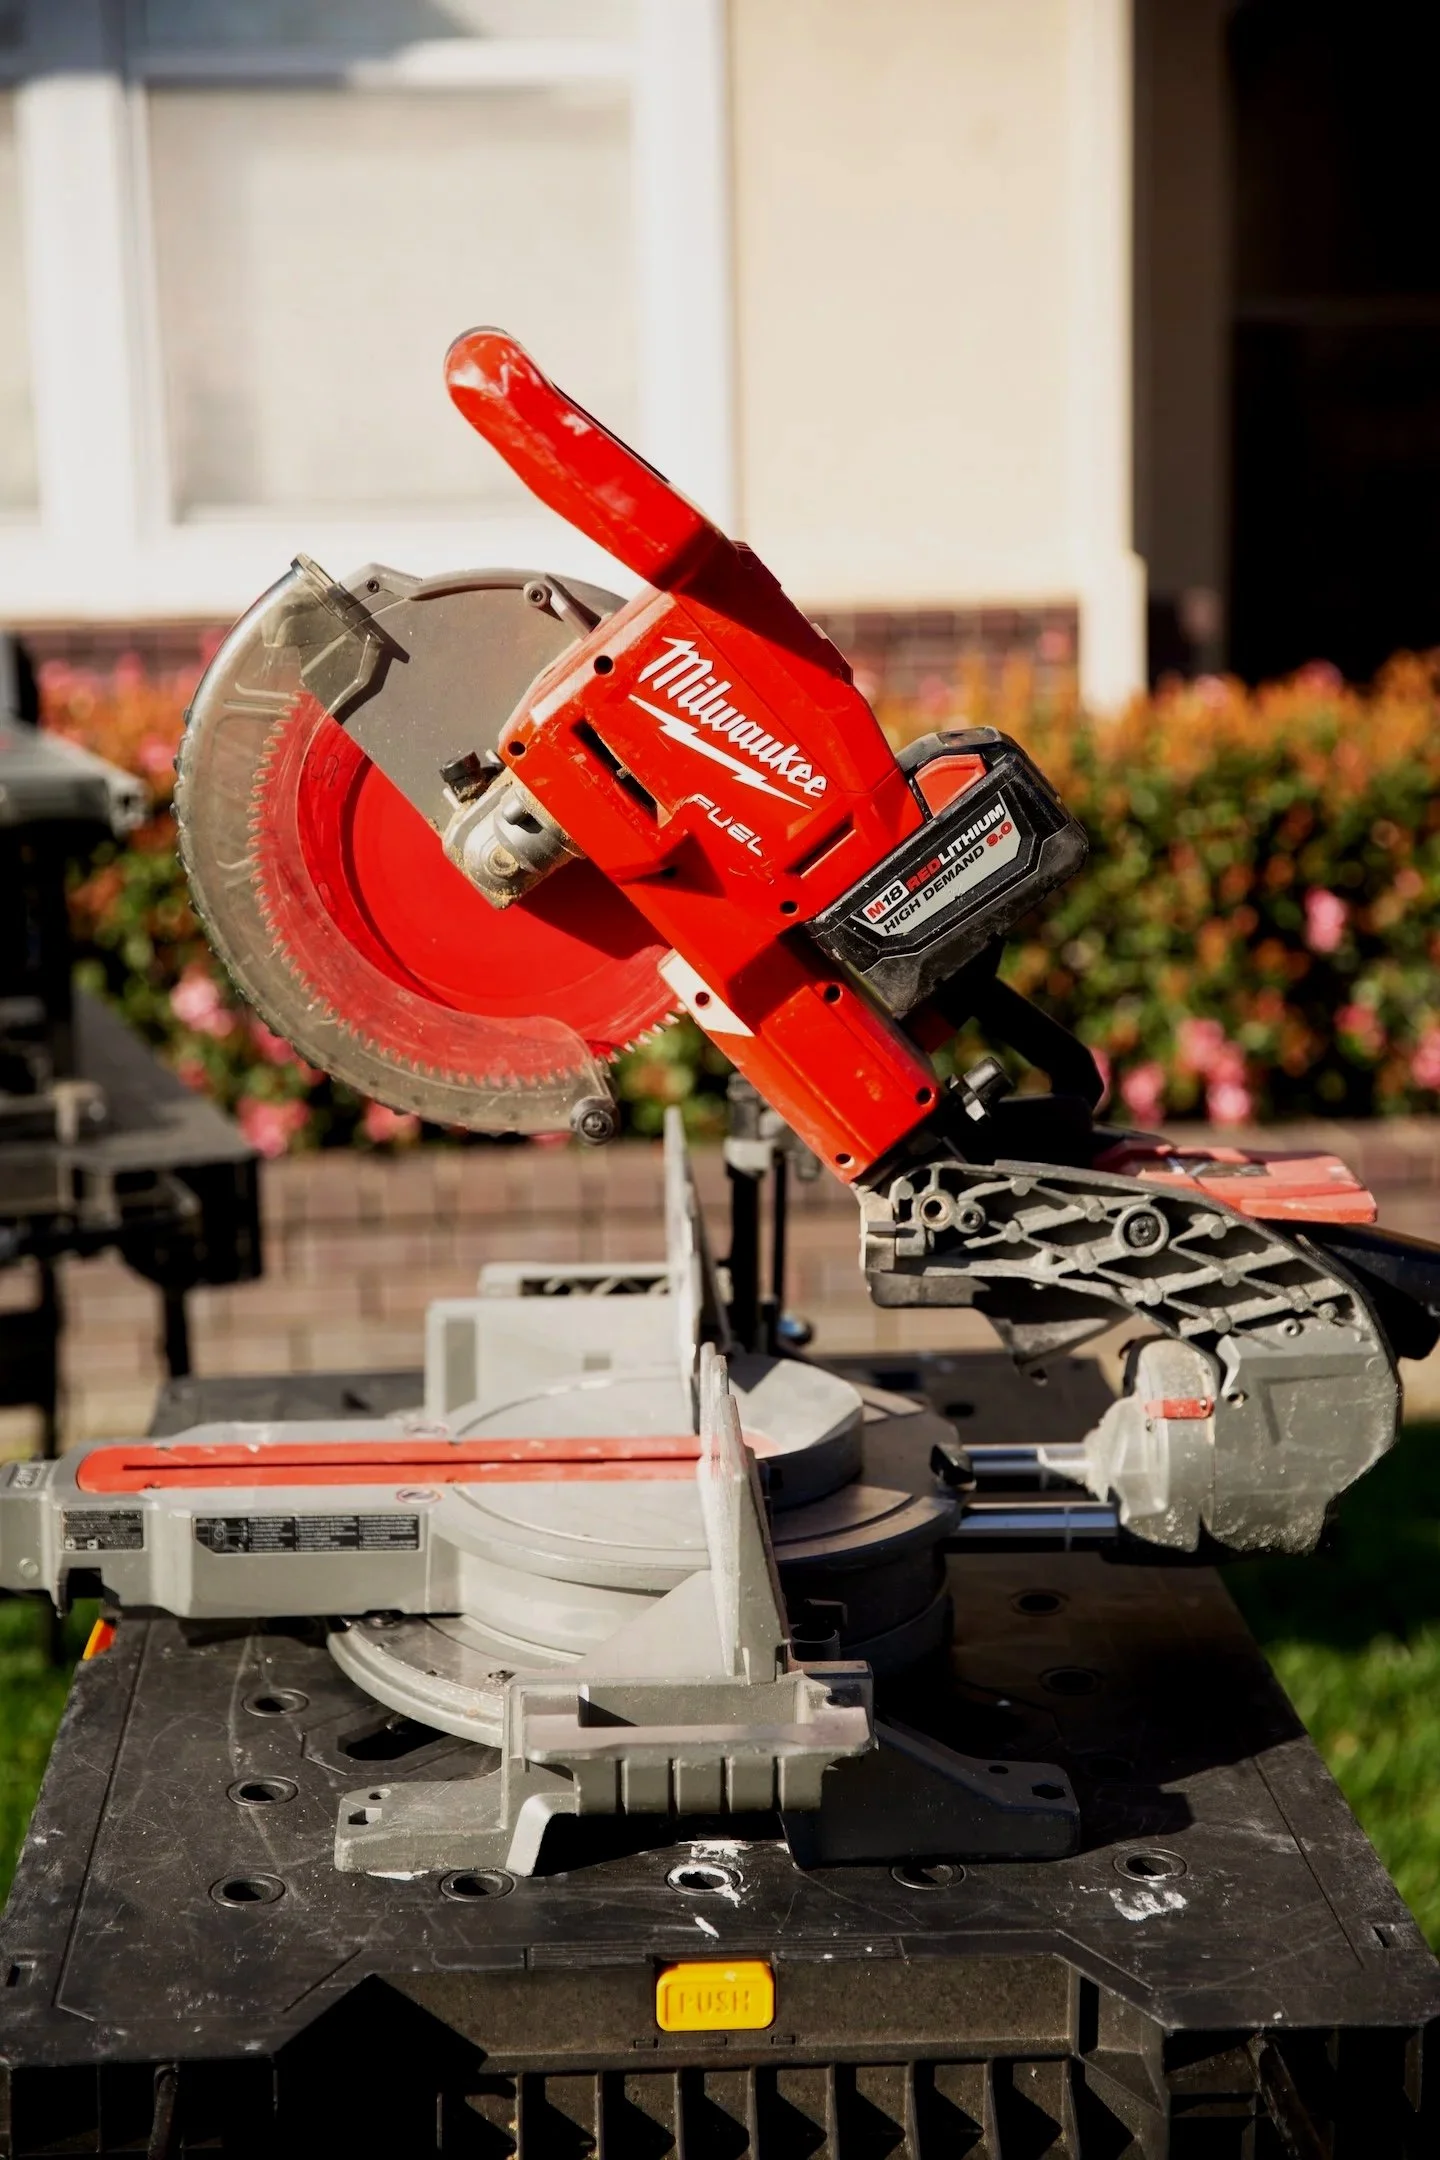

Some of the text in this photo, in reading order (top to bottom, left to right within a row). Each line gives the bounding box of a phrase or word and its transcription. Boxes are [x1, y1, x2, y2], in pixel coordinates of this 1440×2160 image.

[638, 636, 827, 798] Milwaukee
[688, 793, 763, 857] FUEL
[866, 803, 1006, 919] M18 REDLITHIUM
[883, 821, 1013, 934] HIGH DEMAND 9.0
[680, 1990, 749, 2014] PUSH
